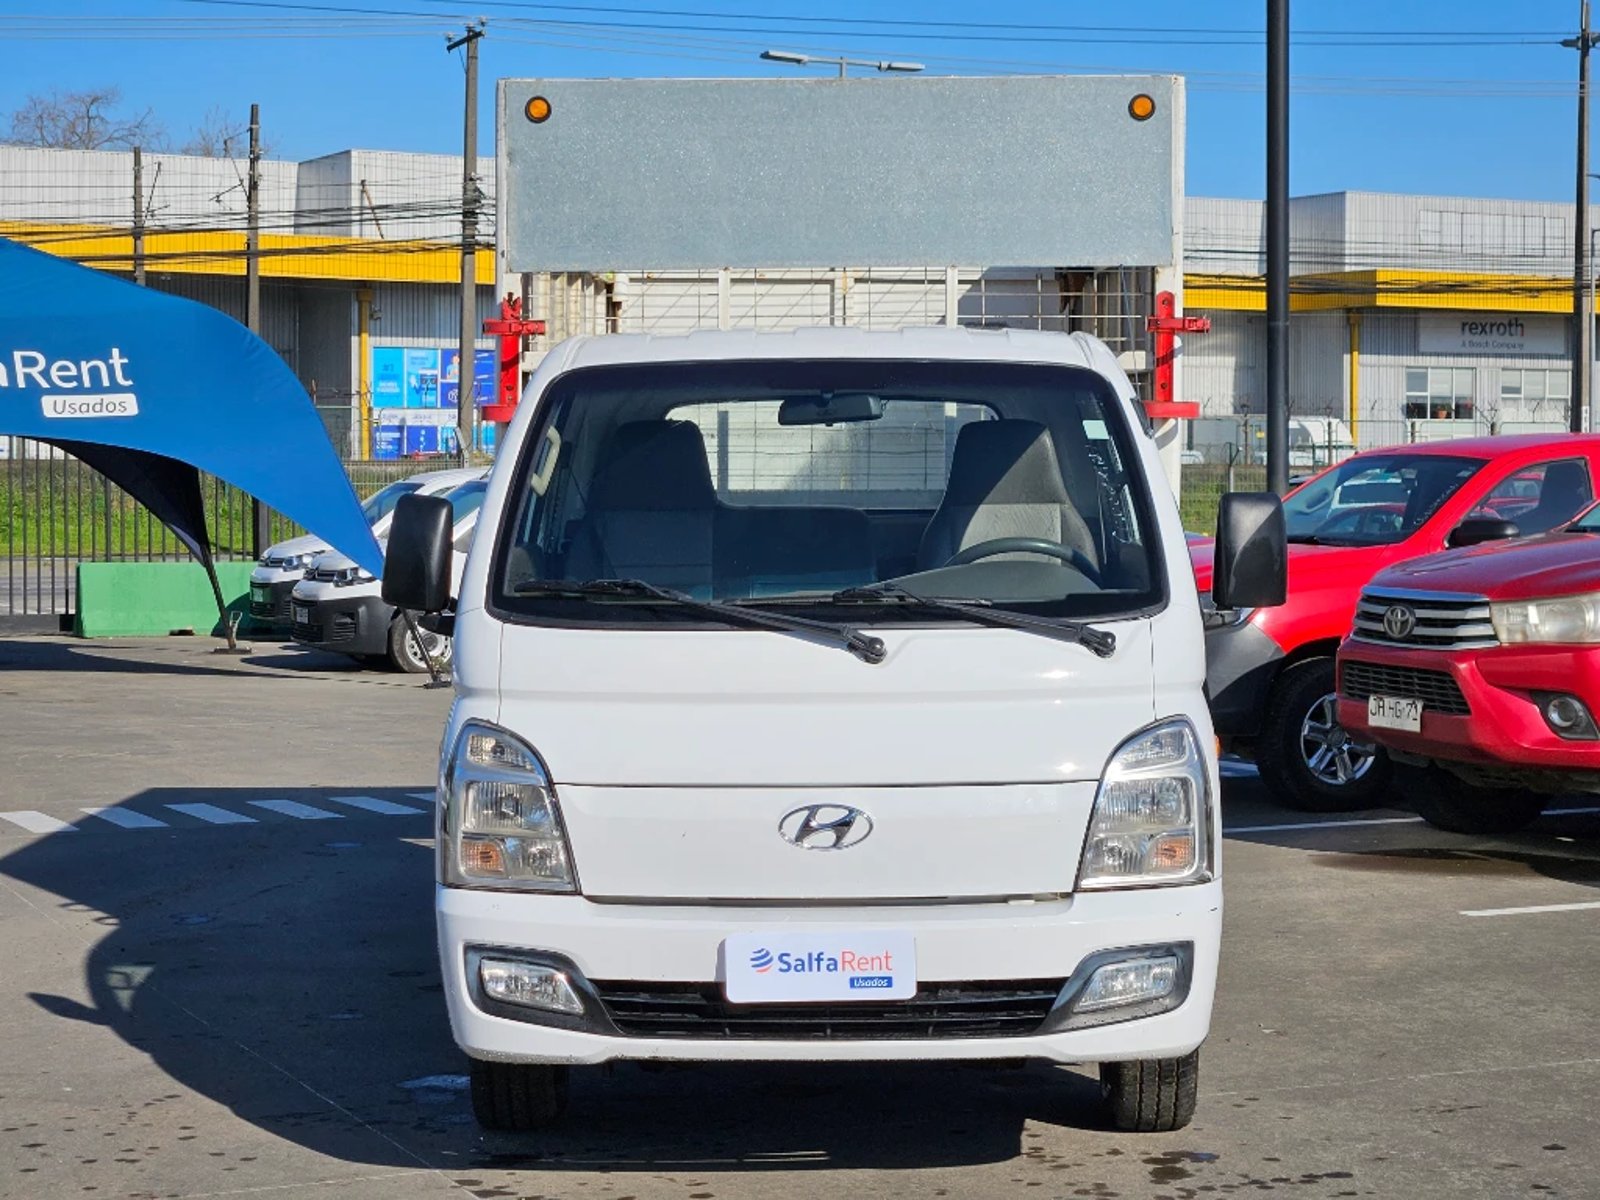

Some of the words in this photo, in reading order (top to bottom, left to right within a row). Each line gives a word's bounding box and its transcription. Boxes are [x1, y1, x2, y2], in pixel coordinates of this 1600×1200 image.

[1461, 317, 1525, 337] rexroth
[53, 398, 128, 415] Usados
[777, 950, 893, 973] SalfaRent
[853, 977, 888, 988] Usados
